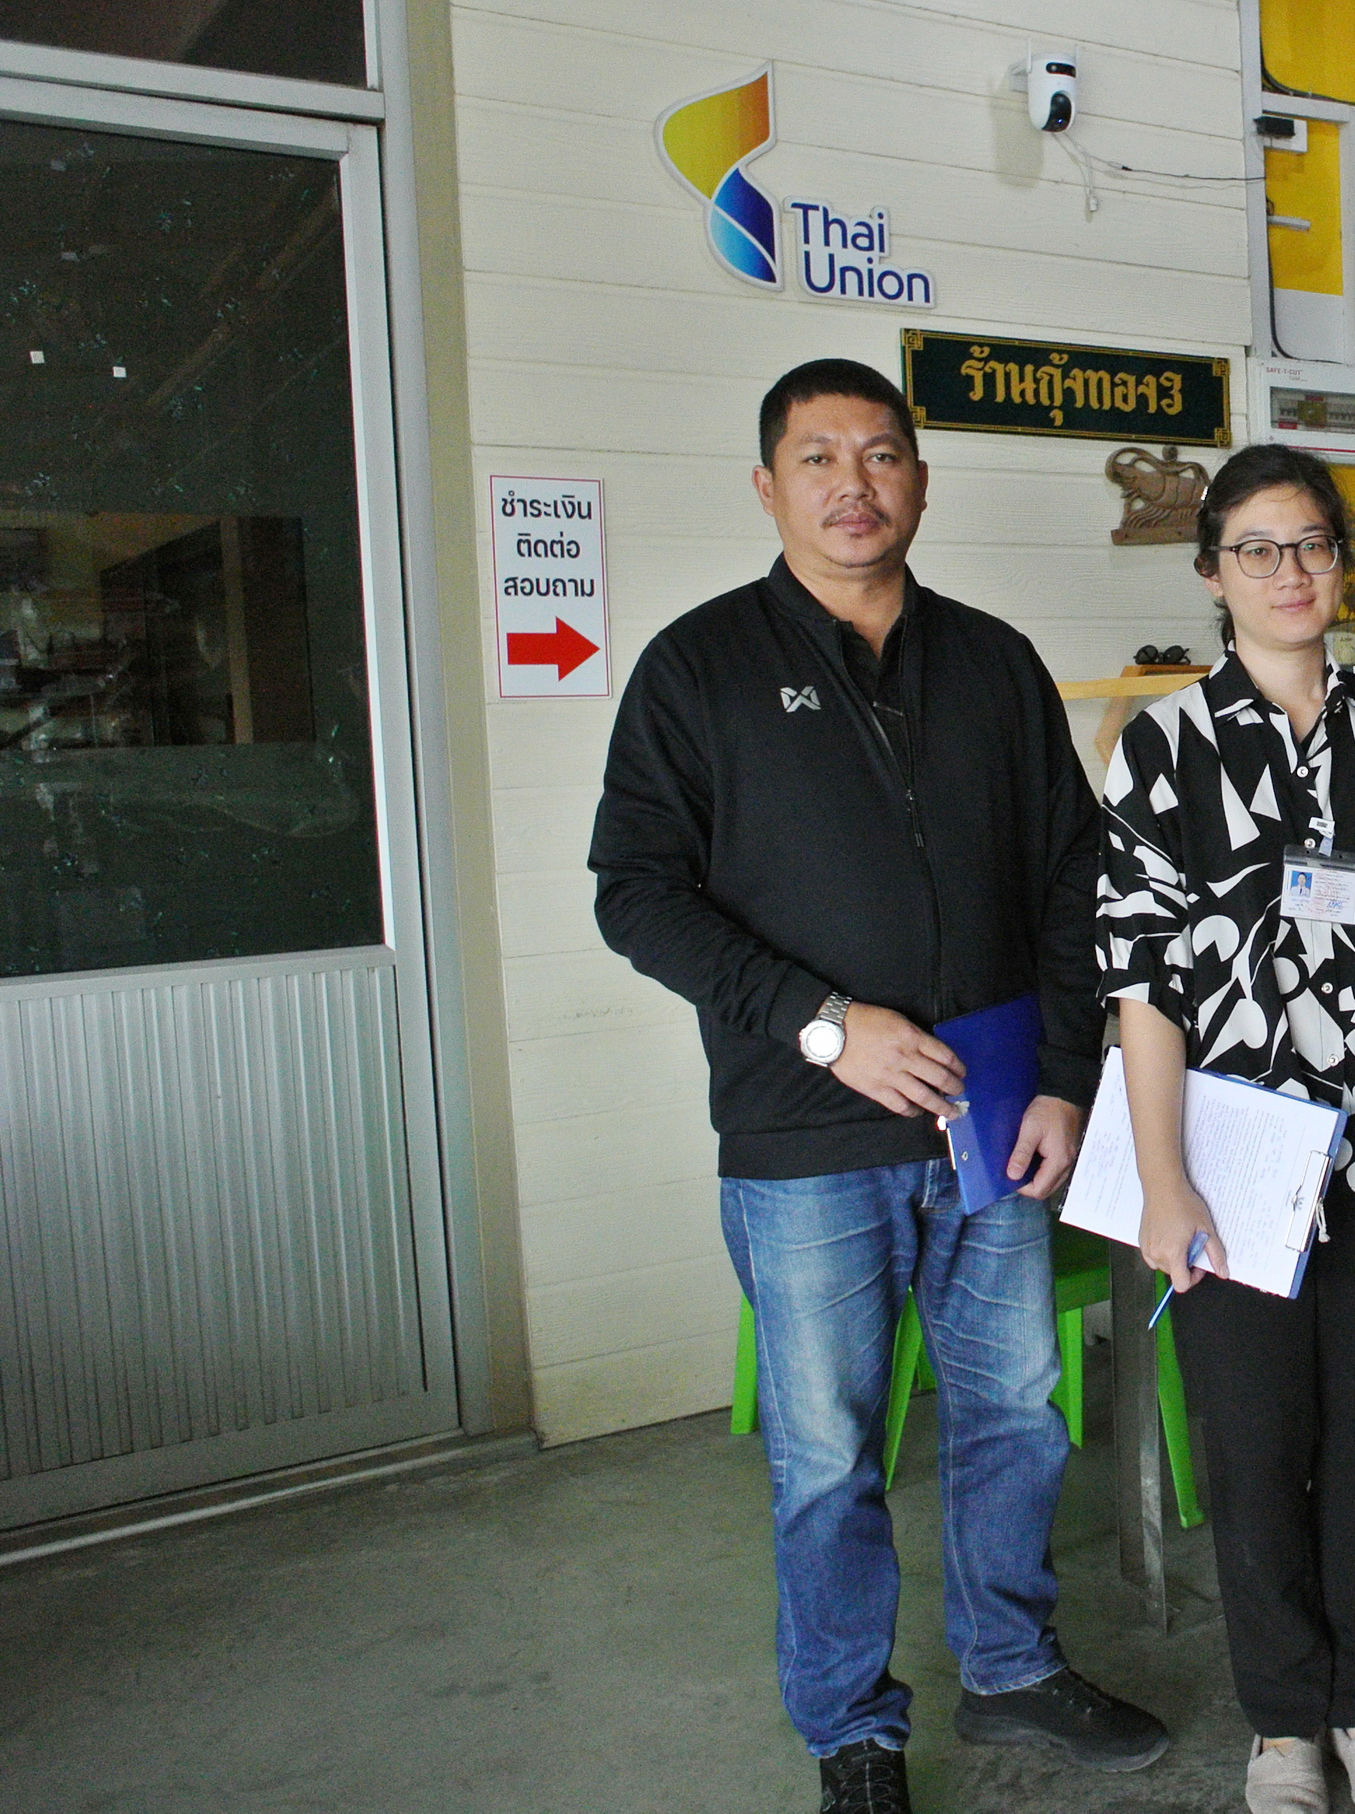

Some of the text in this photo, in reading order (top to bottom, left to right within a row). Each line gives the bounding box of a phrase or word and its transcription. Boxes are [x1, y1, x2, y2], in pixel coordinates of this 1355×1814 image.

[790, 202, 885, 253] Thai
[804, 250, 930, 303] Union
[501, 490, 592, 520] ชำระเงิน
[516, 531, 581, 559] ติดต่อ
[504, 576, 595, 597] สอบถาม
